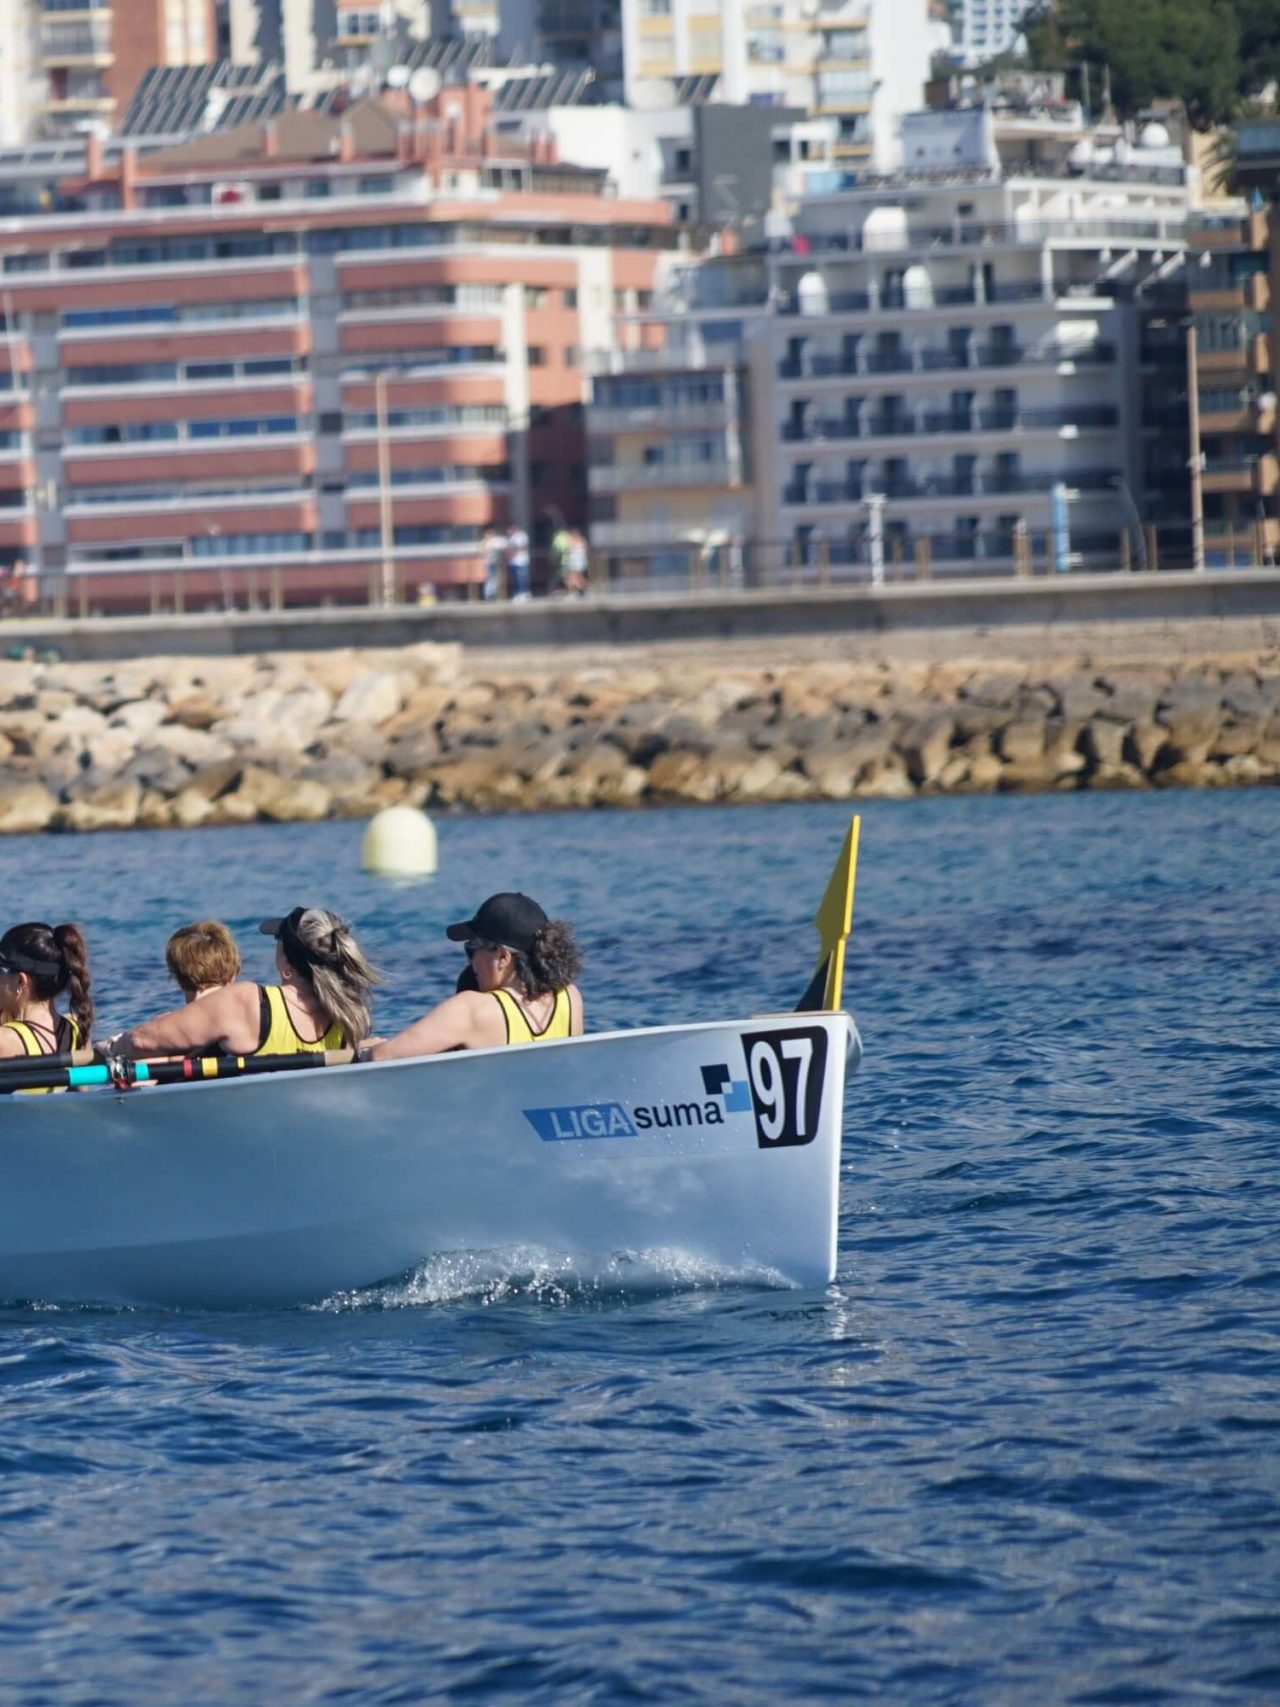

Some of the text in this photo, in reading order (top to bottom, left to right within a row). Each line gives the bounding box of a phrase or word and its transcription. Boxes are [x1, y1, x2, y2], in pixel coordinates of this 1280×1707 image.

[551, 1101, 725, 1138] LIGA suma
[750, 1037, 814, 1140] 97
